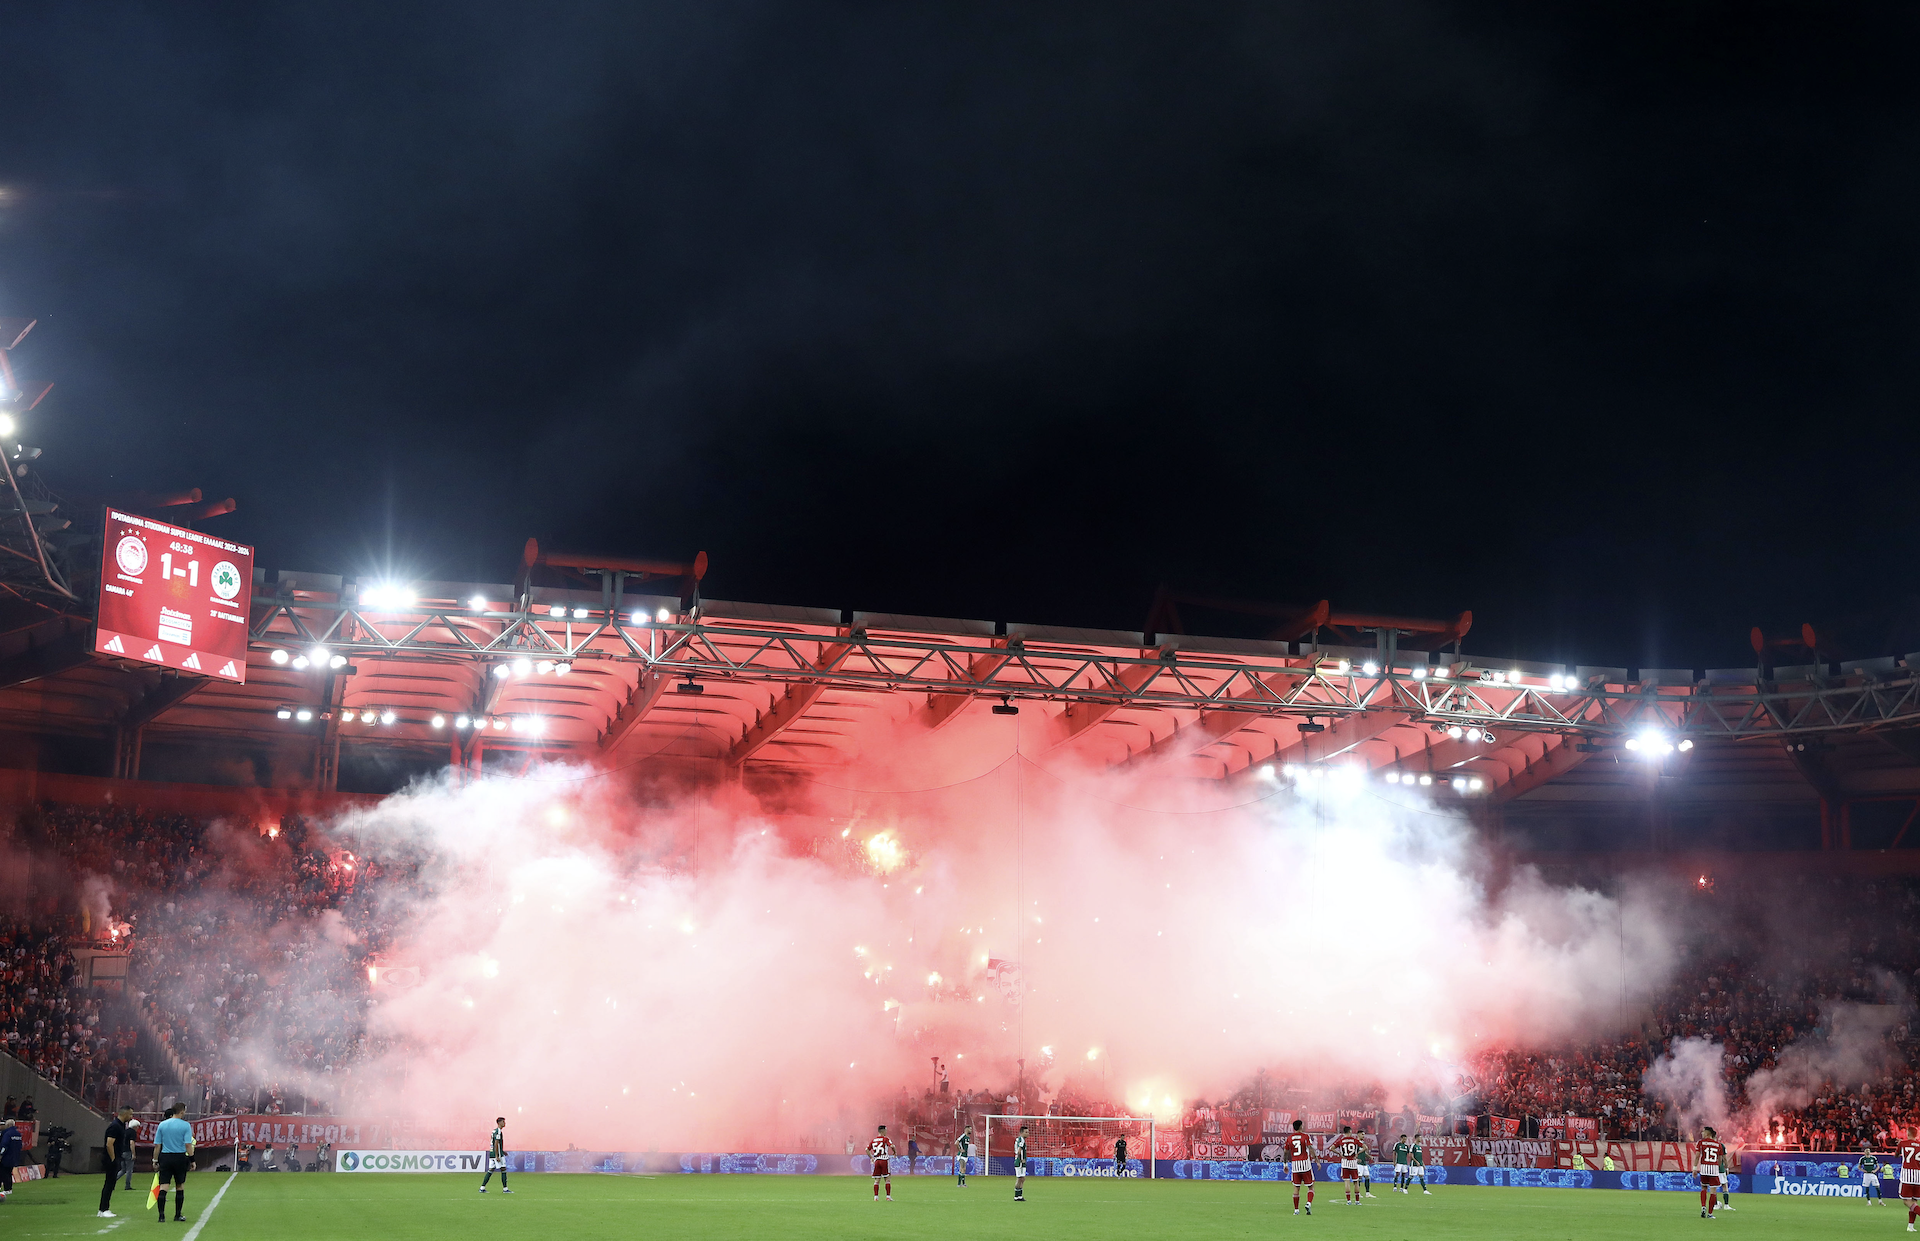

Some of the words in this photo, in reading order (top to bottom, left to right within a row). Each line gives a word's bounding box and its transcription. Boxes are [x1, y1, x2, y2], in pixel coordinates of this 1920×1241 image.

[170, 528, 186, 539] SUPER
[186, 532, 203, 544] LEAGUE
[169, 541, 193, 555] 48:38
[1340, 1110, 1375, 1119] ΚΥΨΕΛΗ
[241, 1122, 360, 1144] KALLIPOLI
[1292, 1140, 1301, 1156] 3
[1342, 1143, 1356, 1157] 19
[1704, 1147, 1718, 1163] 15
[362, 1154, 456, 1170] COSMOTE
[459, 1154, 482, 1170] TV
[1453, 1150, 1463, 1164] 7
[1770, 1176, 1863, 1198] Stoiximan
